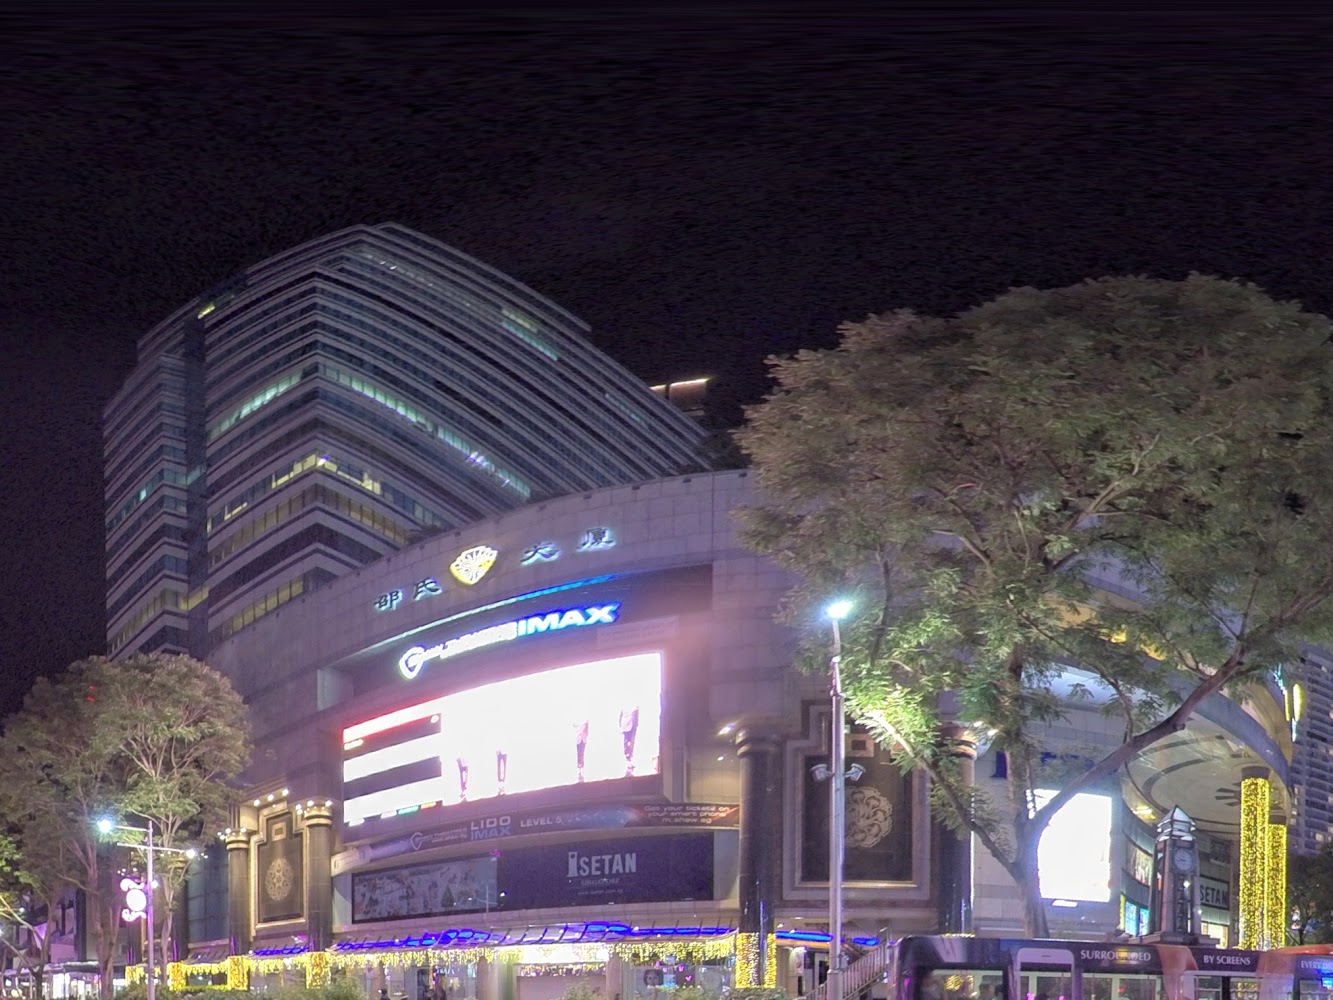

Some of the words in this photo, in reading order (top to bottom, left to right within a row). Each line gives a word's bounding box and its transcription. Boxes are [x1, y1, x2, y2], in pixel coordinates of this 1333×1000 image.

[517, 603, 619, 638] IMAX
[470, 815, 511, 830] LIDO
[520, 817, 553, 828] LEVEL
[471, 826, 511, 841] IMAX
[566, 851, 637, 877] ISETAN
[1200, 884, 1228, 907] SETAN
[1080, 950, 1151, 962] SURROUNDED
[1203, 955, 1214, 964] BY
[1216, 955, 1250, 966] SCREENS
